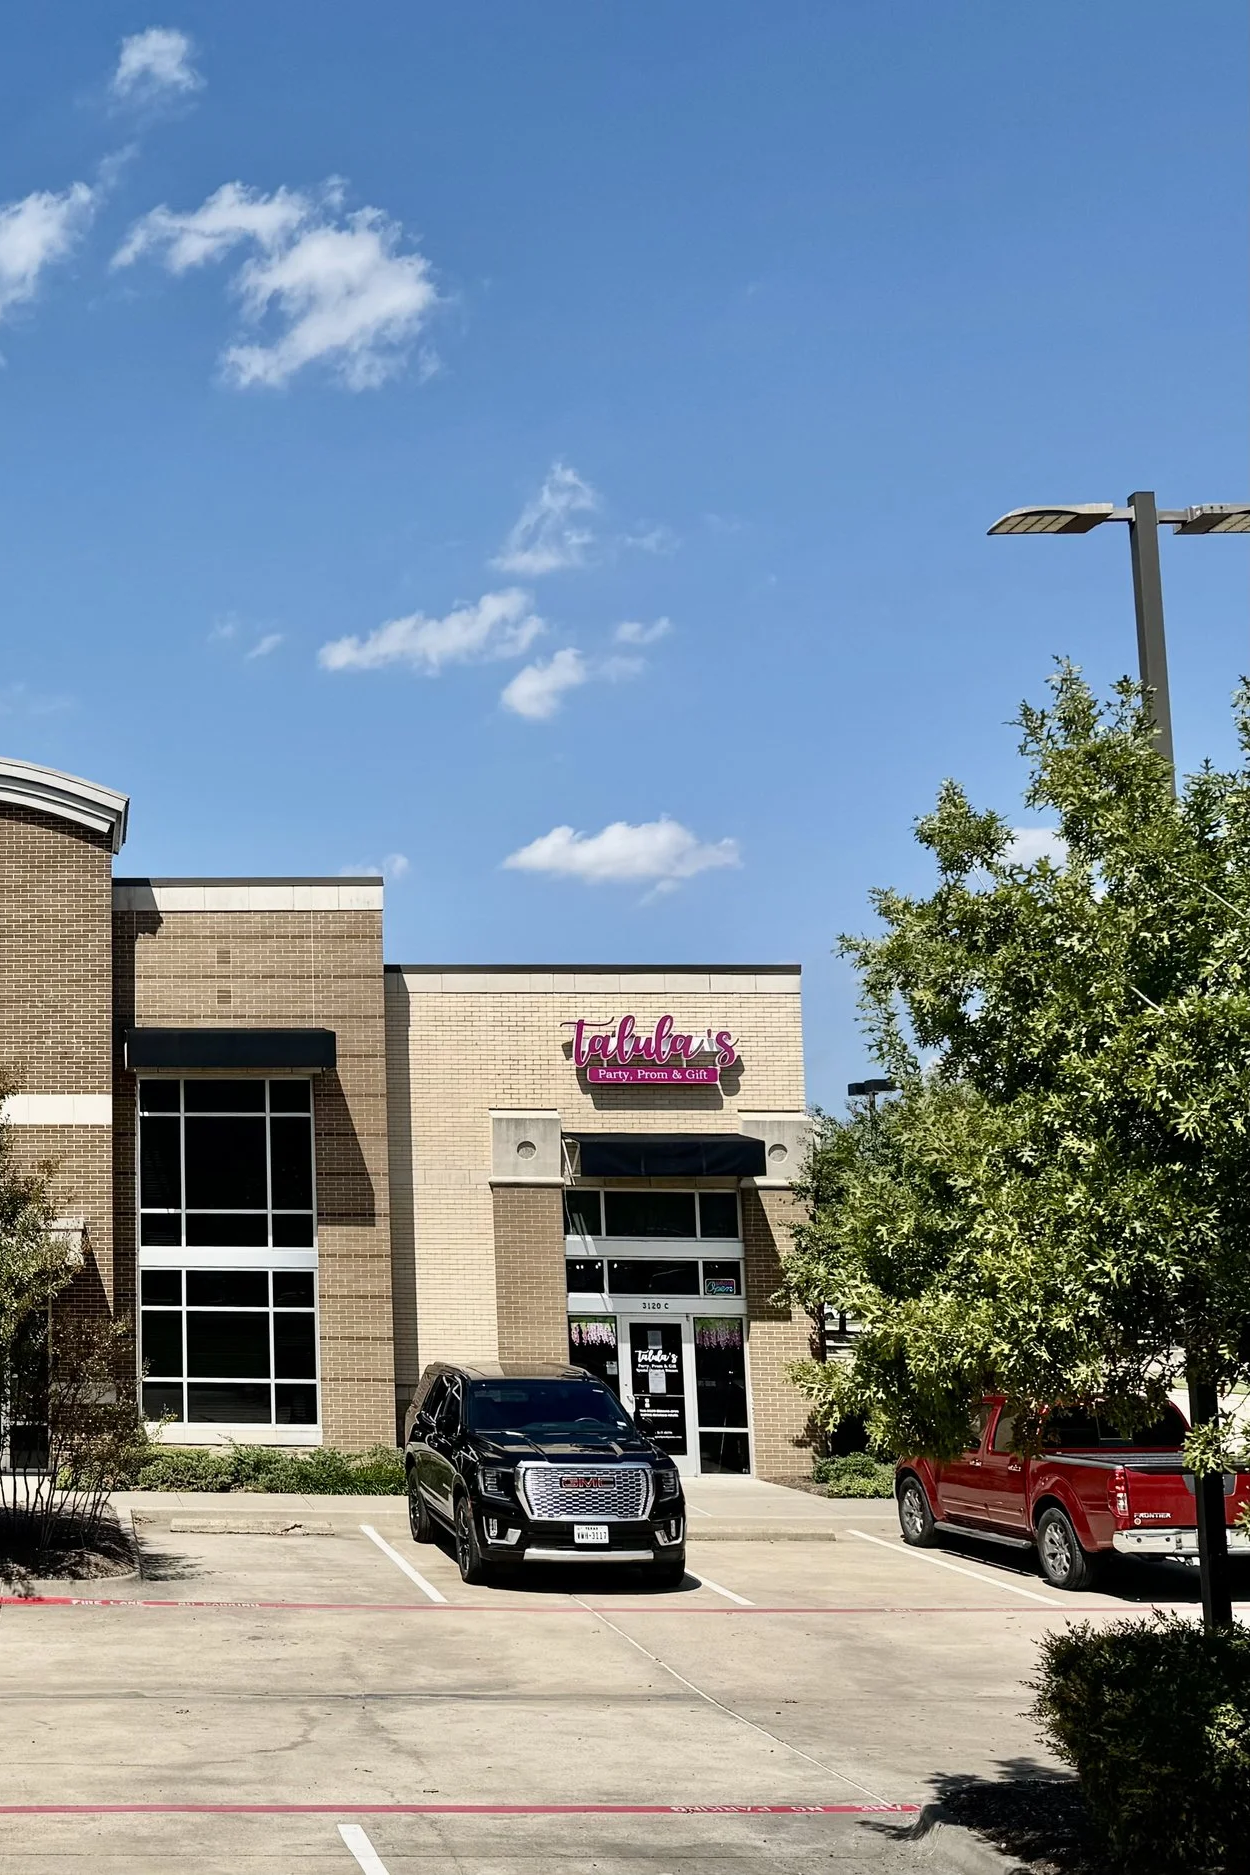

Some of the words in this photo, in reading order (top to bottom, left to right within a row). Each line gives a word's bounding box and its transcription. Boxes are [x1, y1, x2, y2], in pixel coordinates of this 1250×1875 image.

[598, 1069, 633, 1082] Party,
[637, 1069, 668, 1080] Prom
[672, 1069, 682, 1080] &
[685, 1069, 708, 1080] Gift
[706, 1281, 734, 1295] Open
[642, 1302, 662, 1310] 3120
[664, 1302, 669, 1310] C
[561, 1477, 614, 1489] GMC
